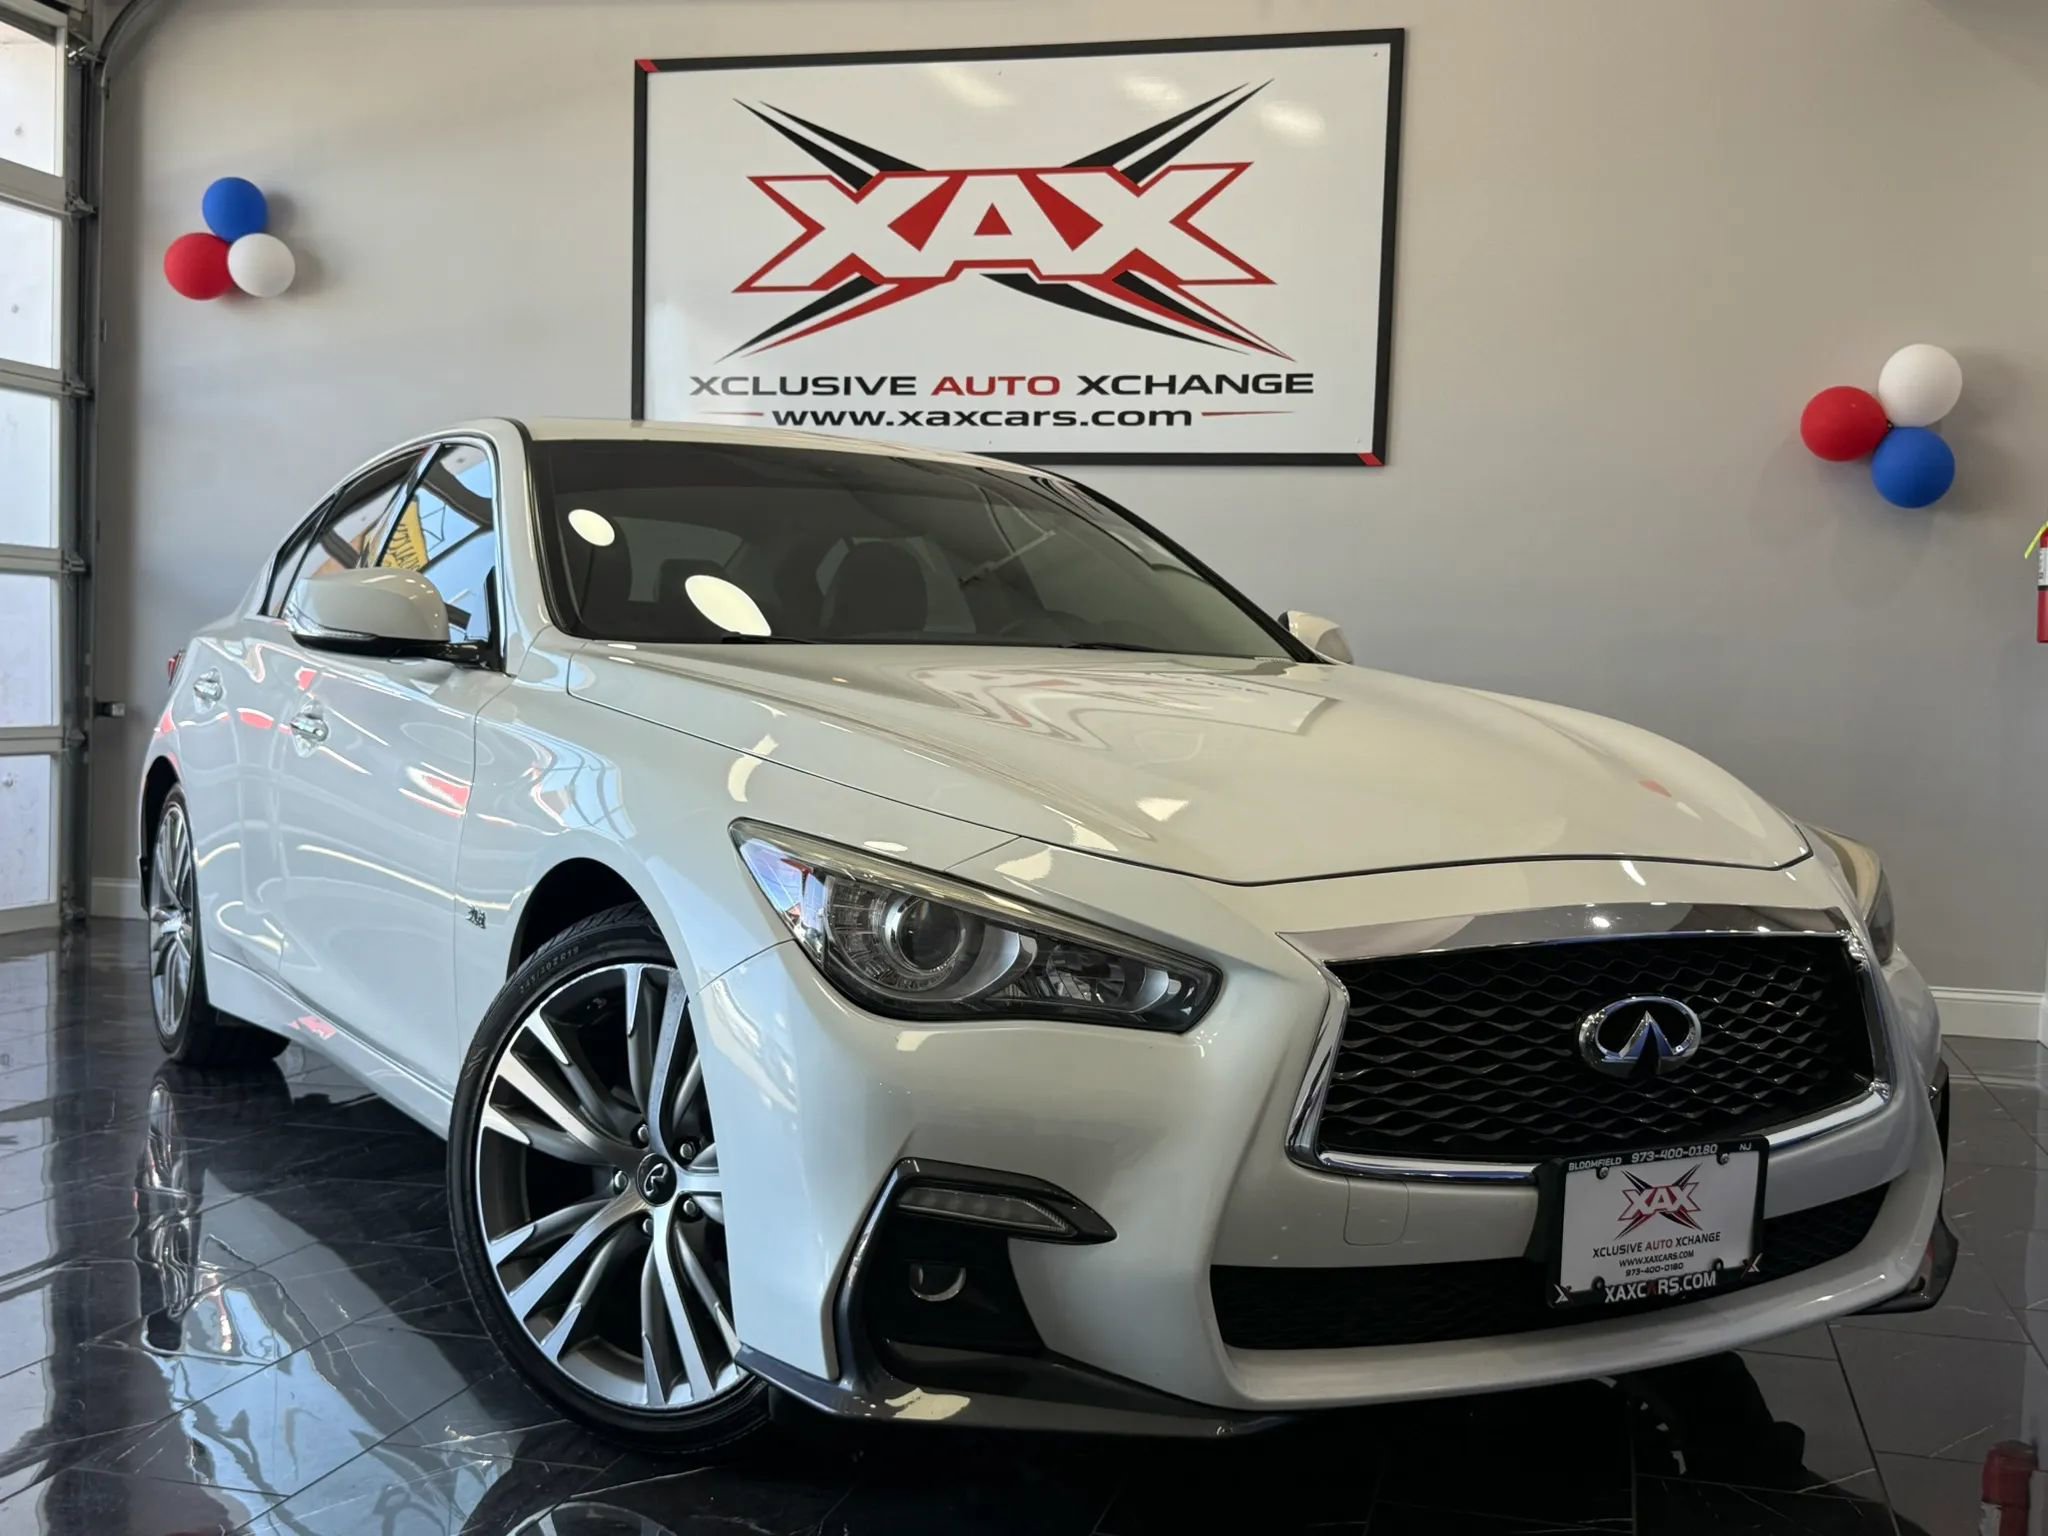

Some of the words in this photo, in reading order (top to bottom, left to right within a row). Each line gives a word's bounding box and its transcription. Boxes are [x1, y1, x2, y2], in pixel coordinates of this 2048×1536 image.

[732, 161, 1277, 293] XAX
[688, 375, 917, 397] XCLUSIVE
[930, 374, 1061, 396] AUTO
[1076, 372, 1315, 396] XCHANGE
[771, 407, 1193, 427] www.xaxcars.com
[1568, 1156, 1622, 1171] BLOOMFIELD
[1631, 1143, 1718, 1164] 973-400-0180
[1739, 1143, 1752, 1151] NJ
[1617, 1182, 1701, 1221] XAX
[1592, 1242, 1642, 1258] XCLUSIVE
[1645, 1238, 1673, 1252] AUTO
[1675, 1231, 1721, 1247] XCHANGE
